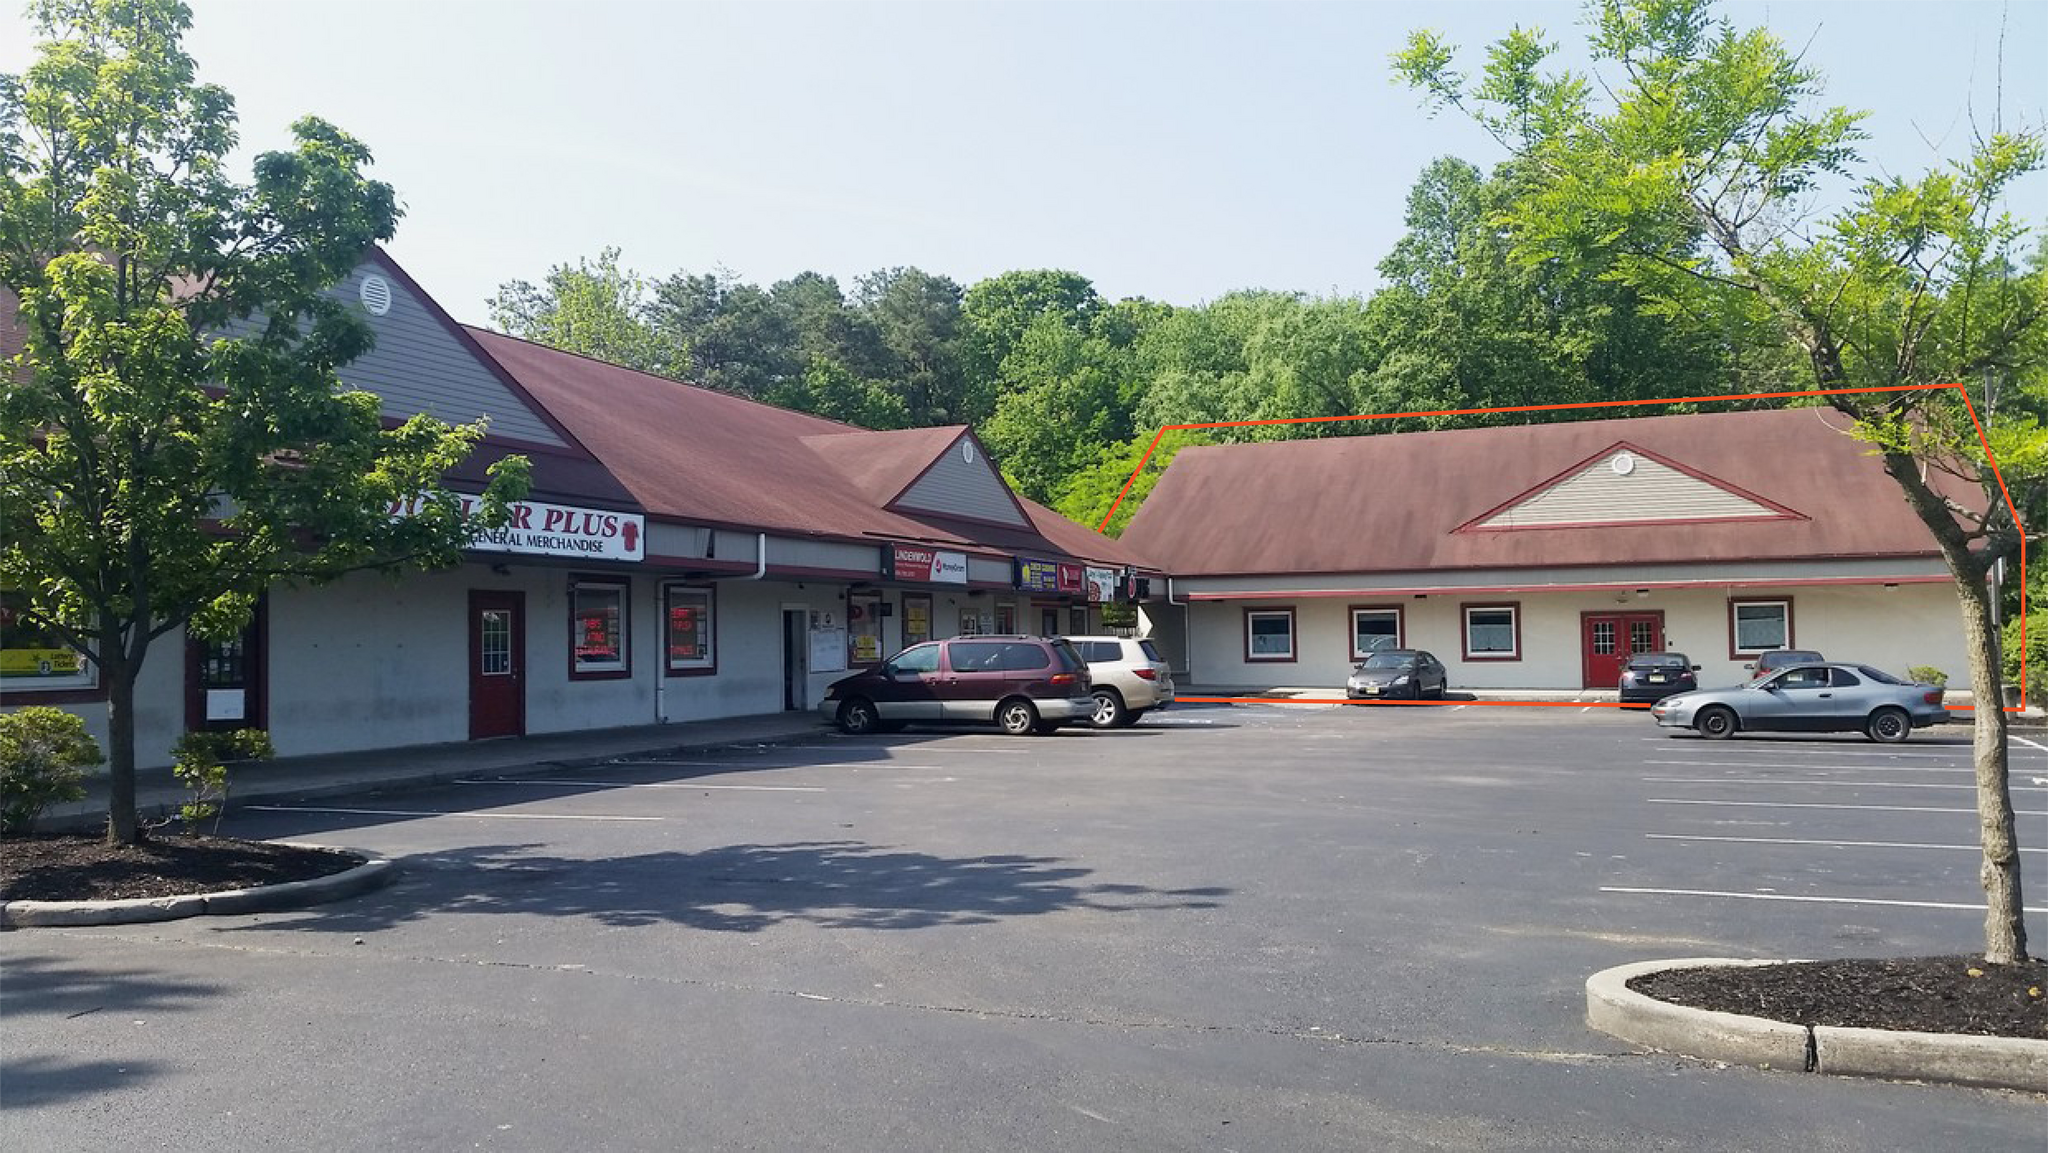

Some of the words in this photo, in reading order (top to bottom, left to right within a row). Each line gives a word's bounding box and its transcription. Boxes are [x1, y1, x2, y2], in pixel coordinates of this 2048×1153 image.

[542, 508, 619, 538] PLUS
[471, 531, 523, 546] GENERAL
[526, 535, 604, 553] MERCHANDISE
